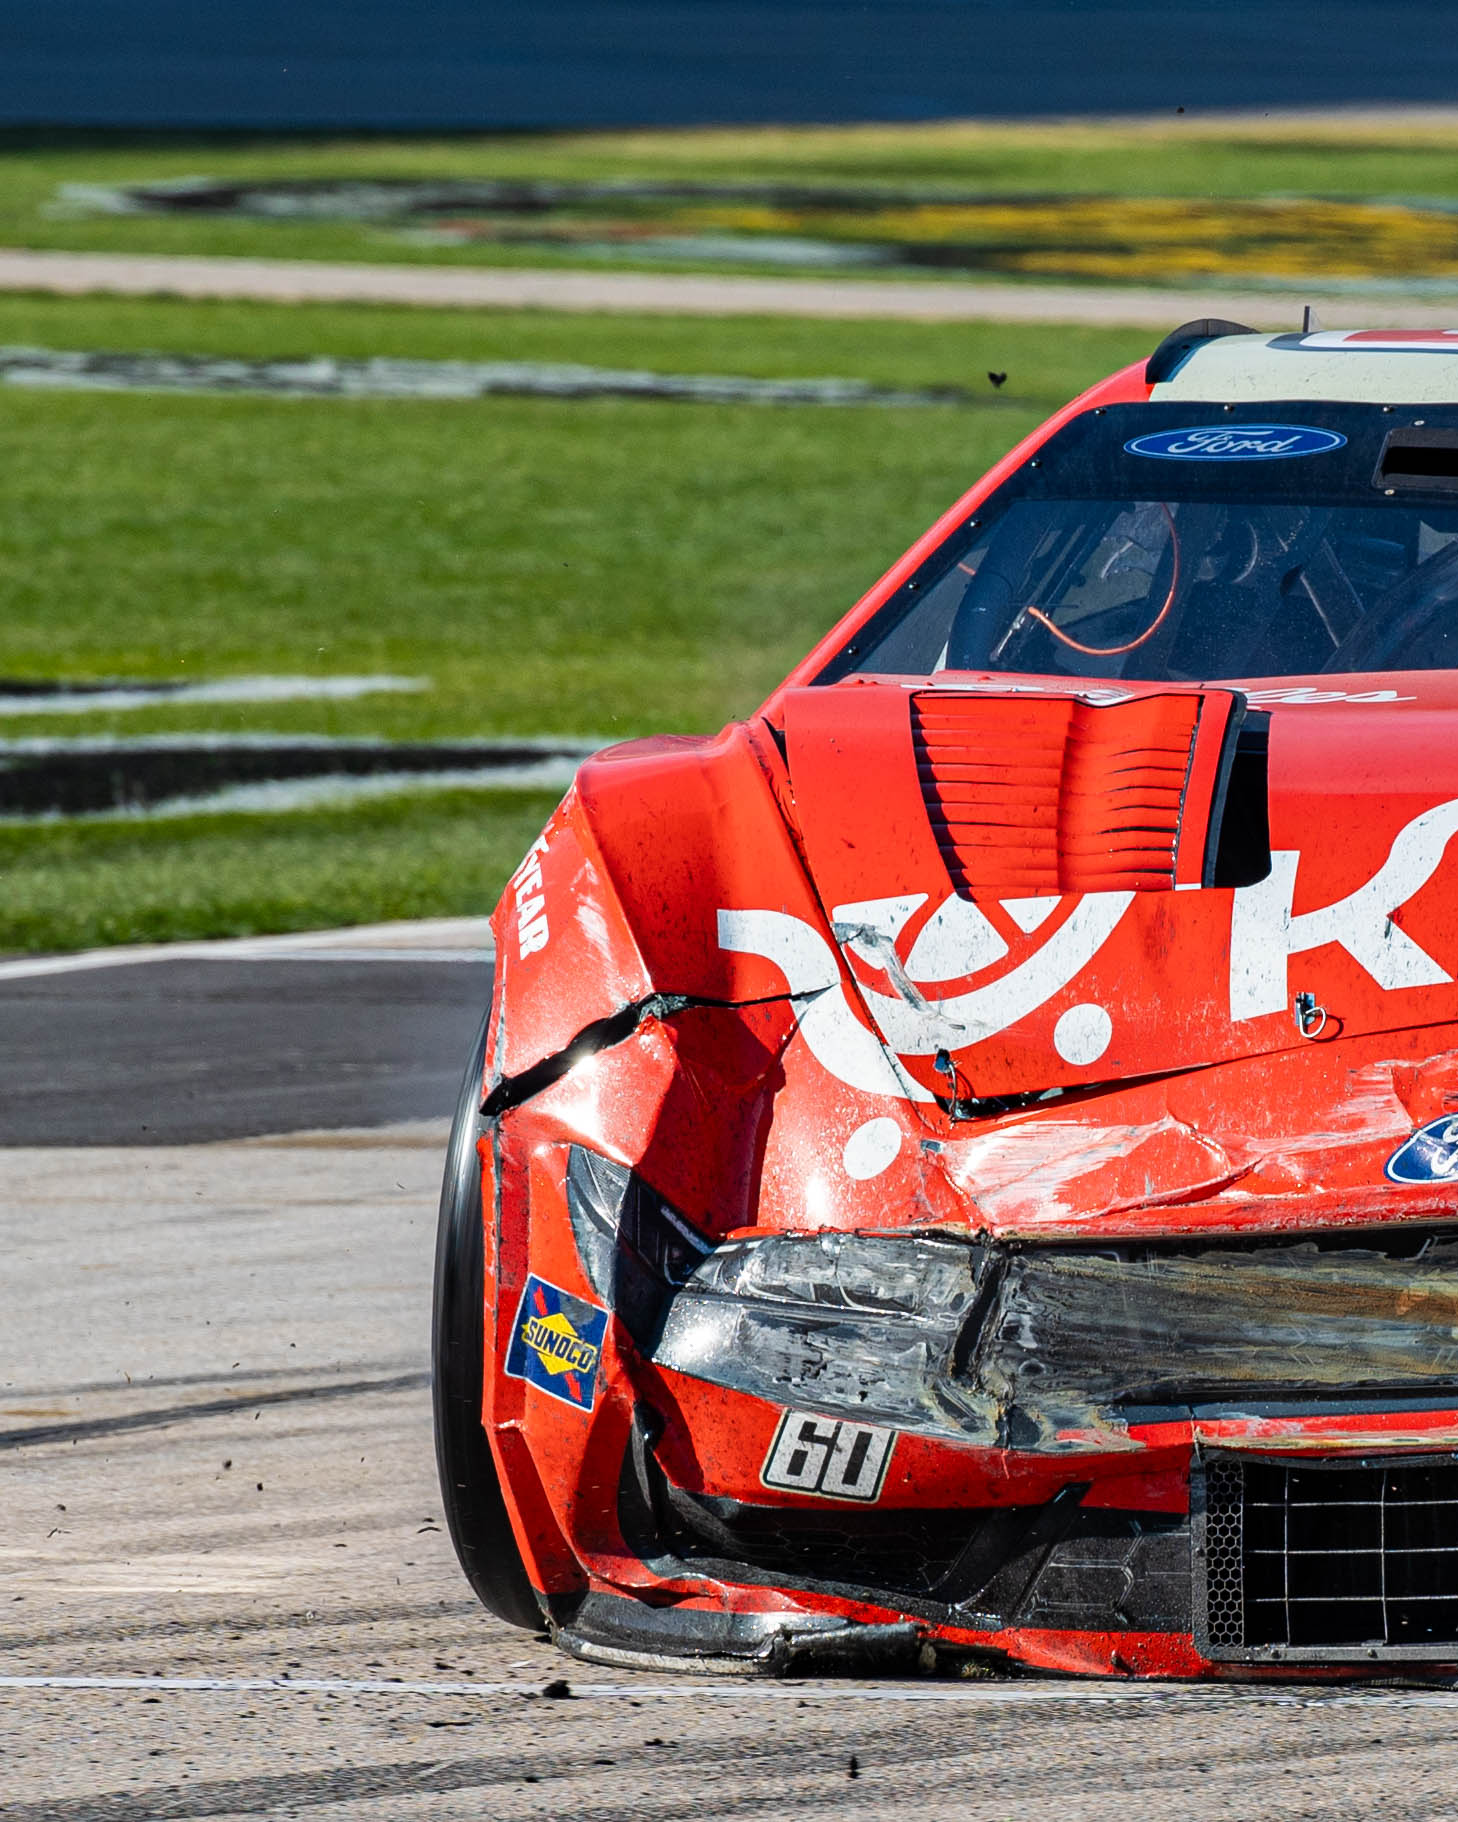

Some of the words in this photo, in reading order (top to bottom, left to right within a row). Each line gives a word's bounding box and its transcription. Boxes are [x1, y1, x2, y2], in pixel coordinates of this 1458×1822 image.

[1167, 429, 1303, 454] Ford
[510, 824, 551, 960] YEAR
[523, 1318, 596, 1371] SUNOCO
[763, 1409, 897, 1499] 60
